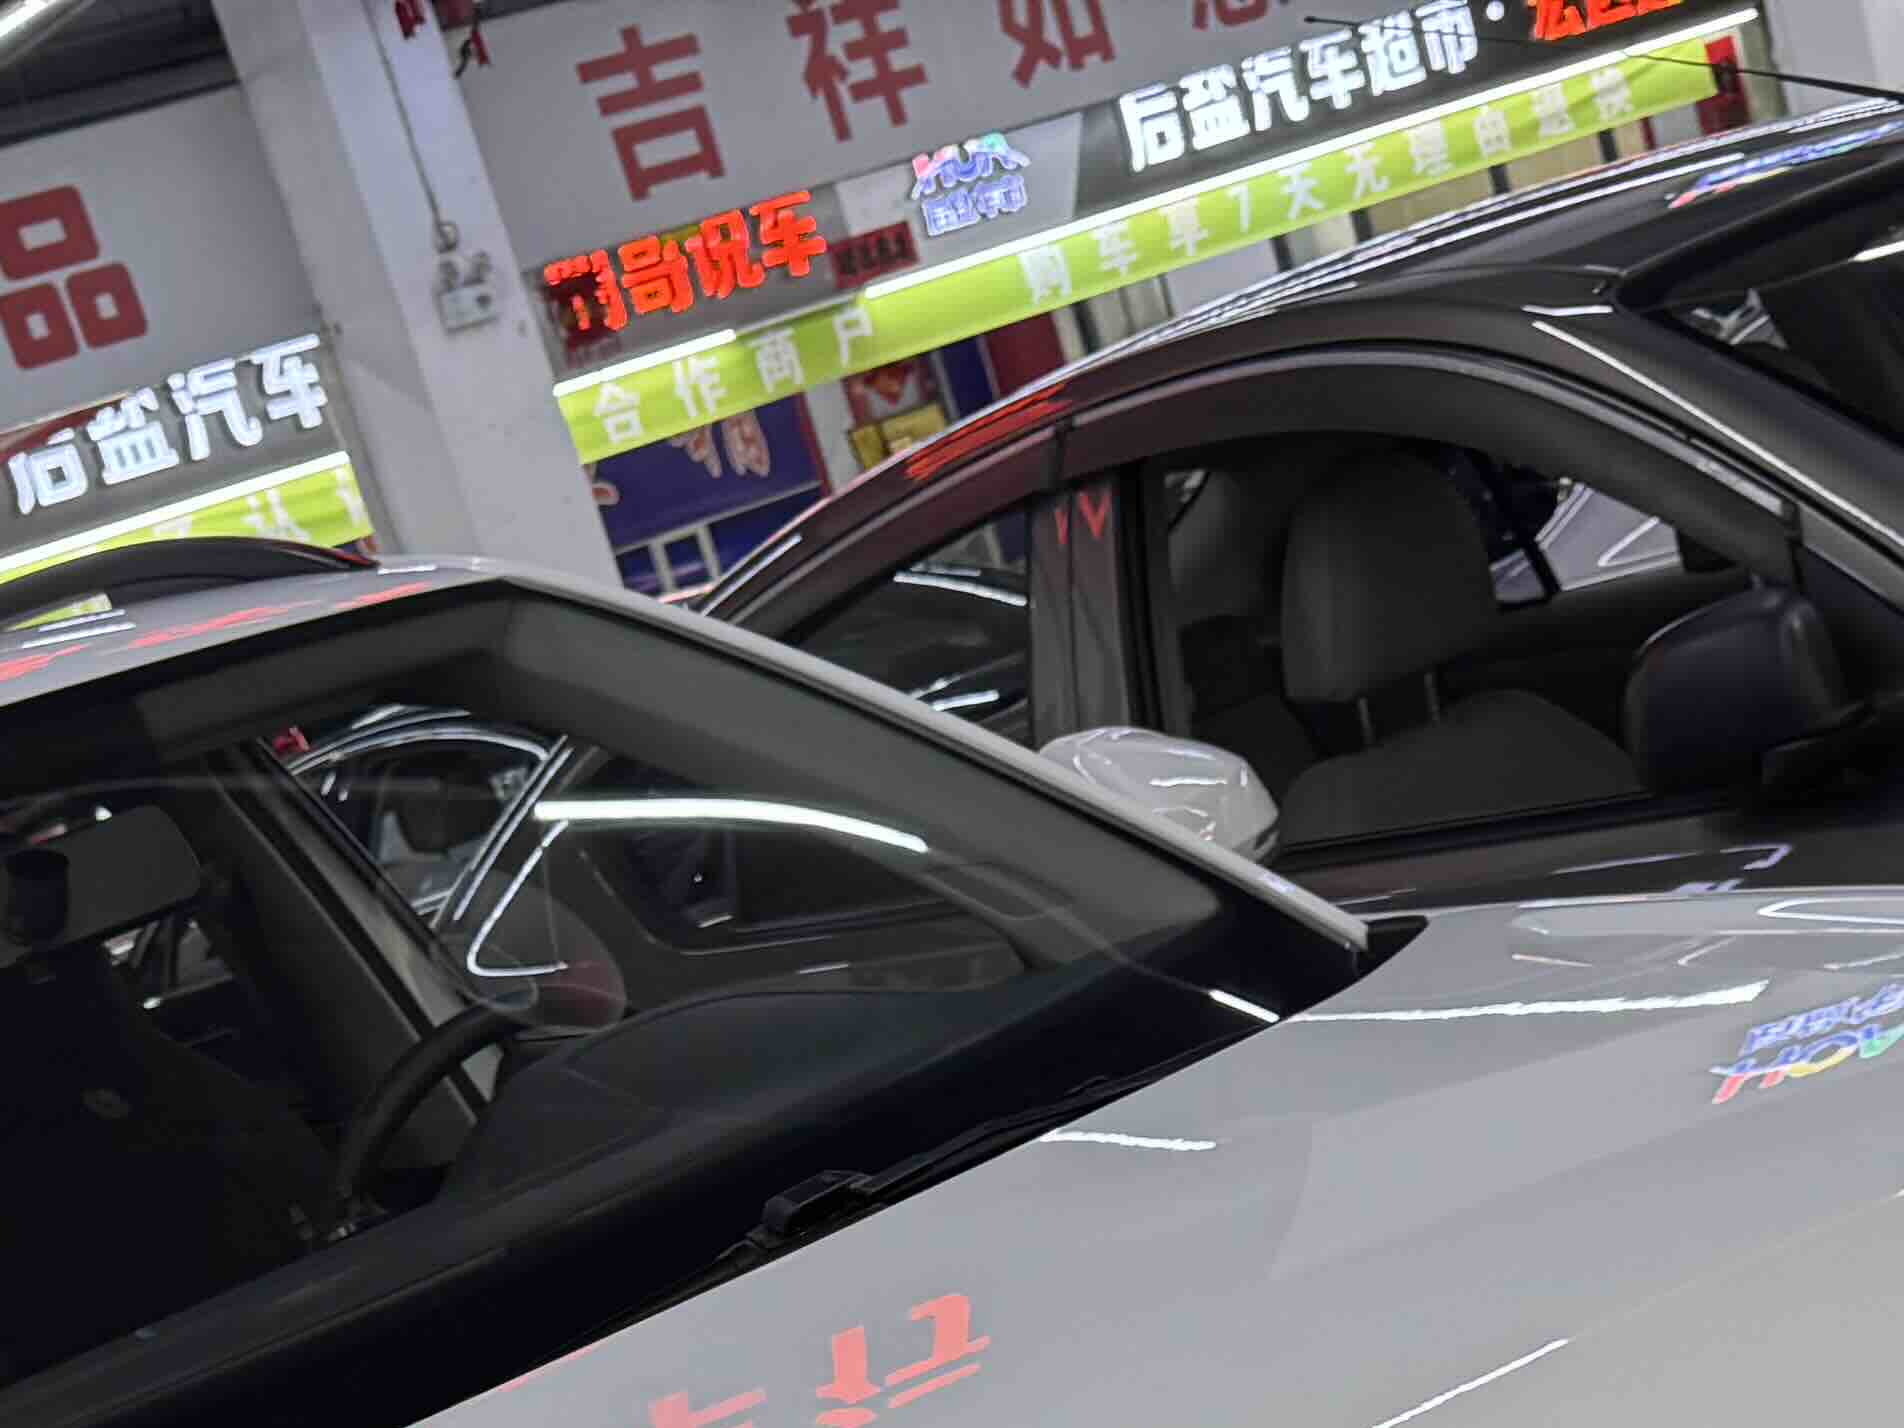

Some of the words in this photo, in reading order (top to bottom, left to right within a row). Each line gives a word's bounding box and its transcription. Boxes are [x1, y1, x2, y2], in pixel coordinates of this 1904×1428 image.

[1120, 2, 1479, 172] 后盐汽车超市
[593, 304, 875, 445] 合作商户
